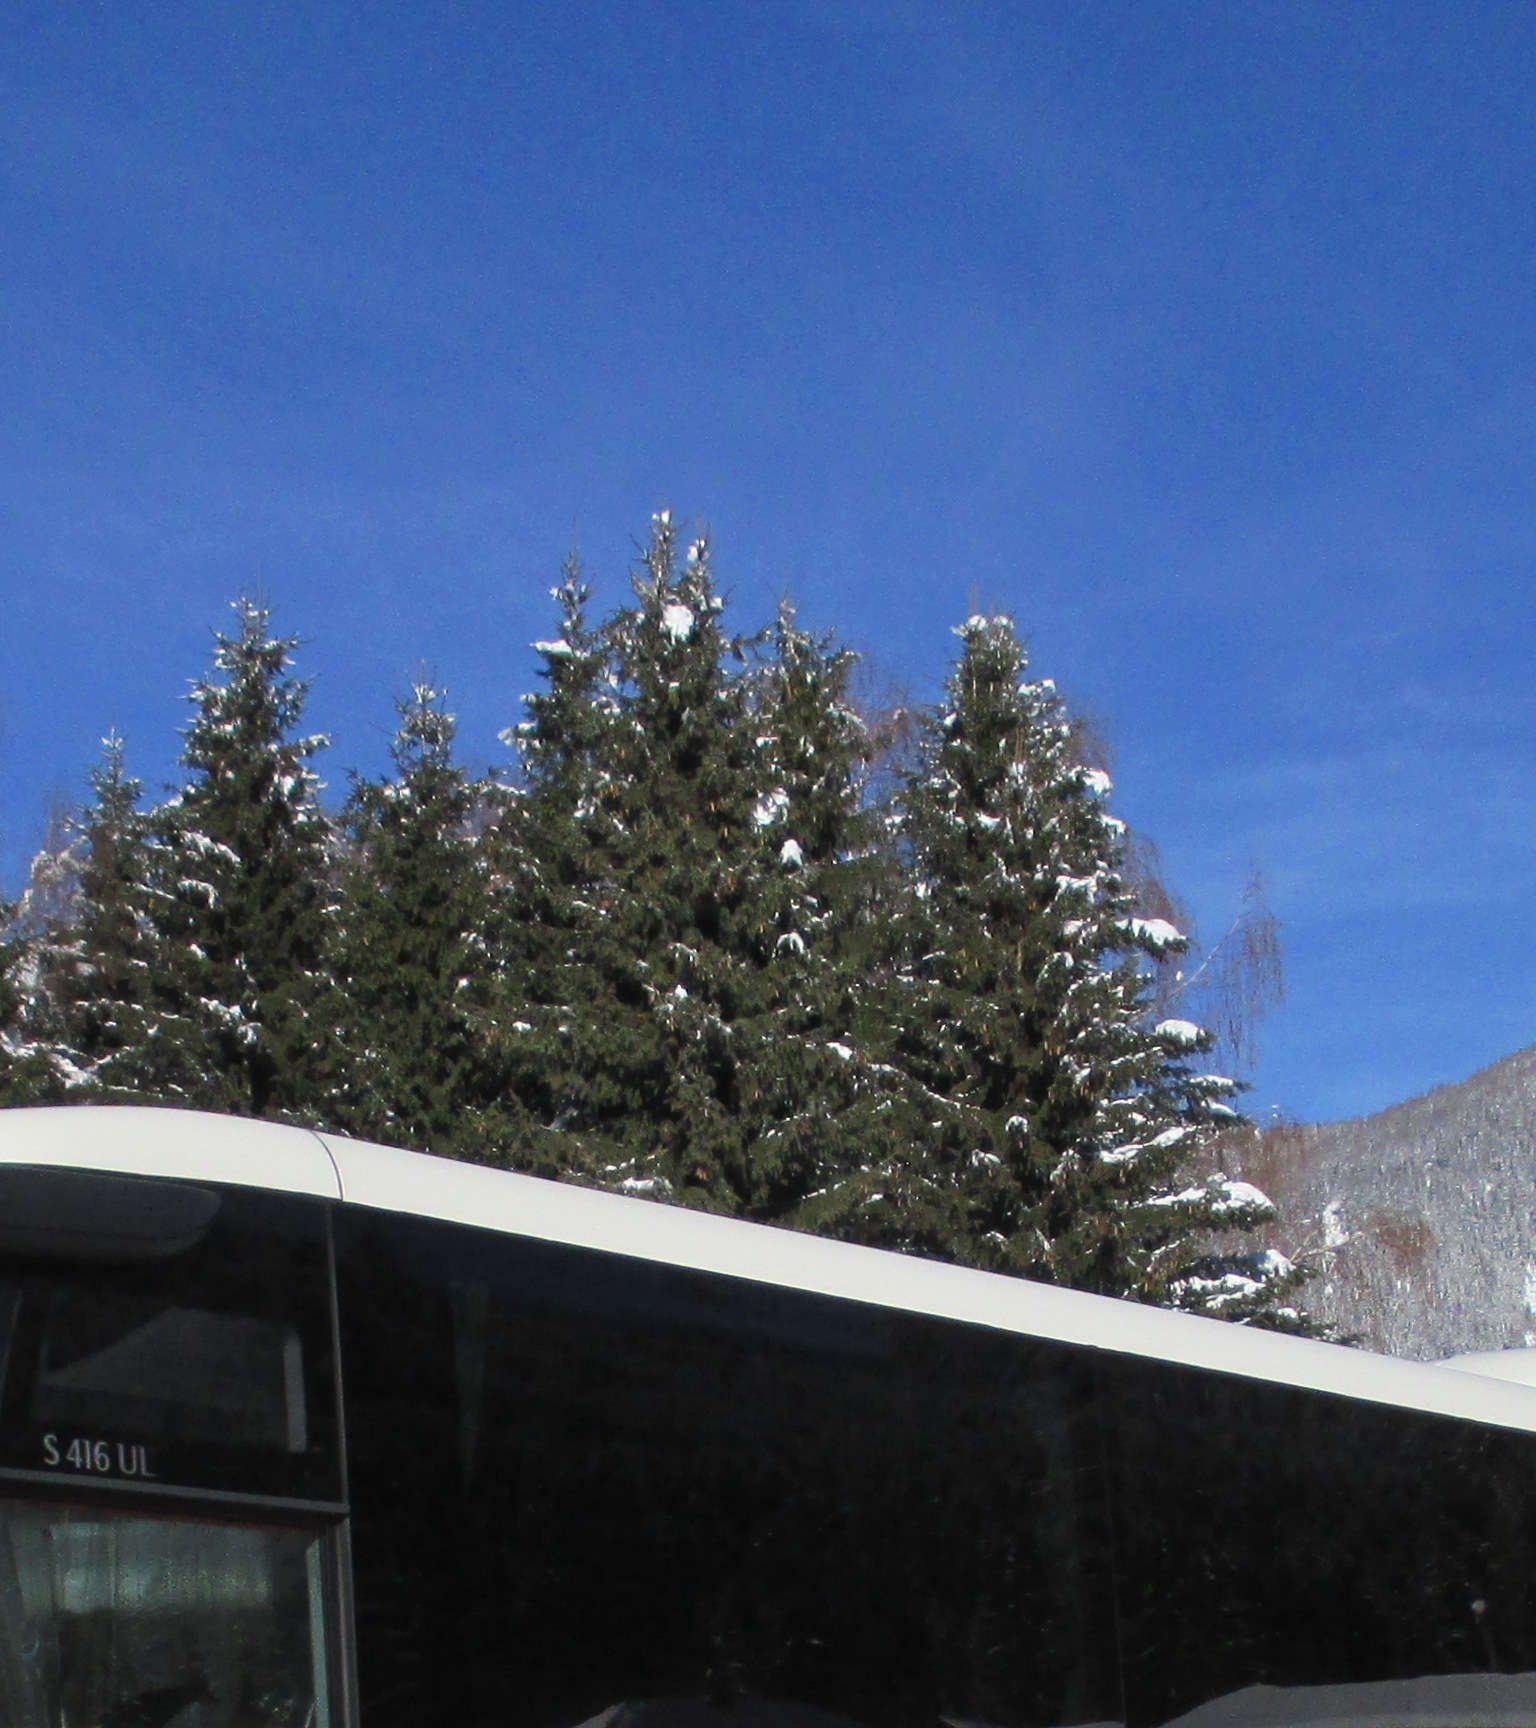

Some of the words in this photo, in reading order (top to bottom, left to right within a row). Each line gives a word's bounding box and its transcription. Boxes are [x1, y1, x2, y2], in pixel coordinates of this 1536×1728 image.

[43, 1434, 60, 1466] S
[65, 1438, 110, 1471] 416
[116, 1442, 158, 1477] UL
